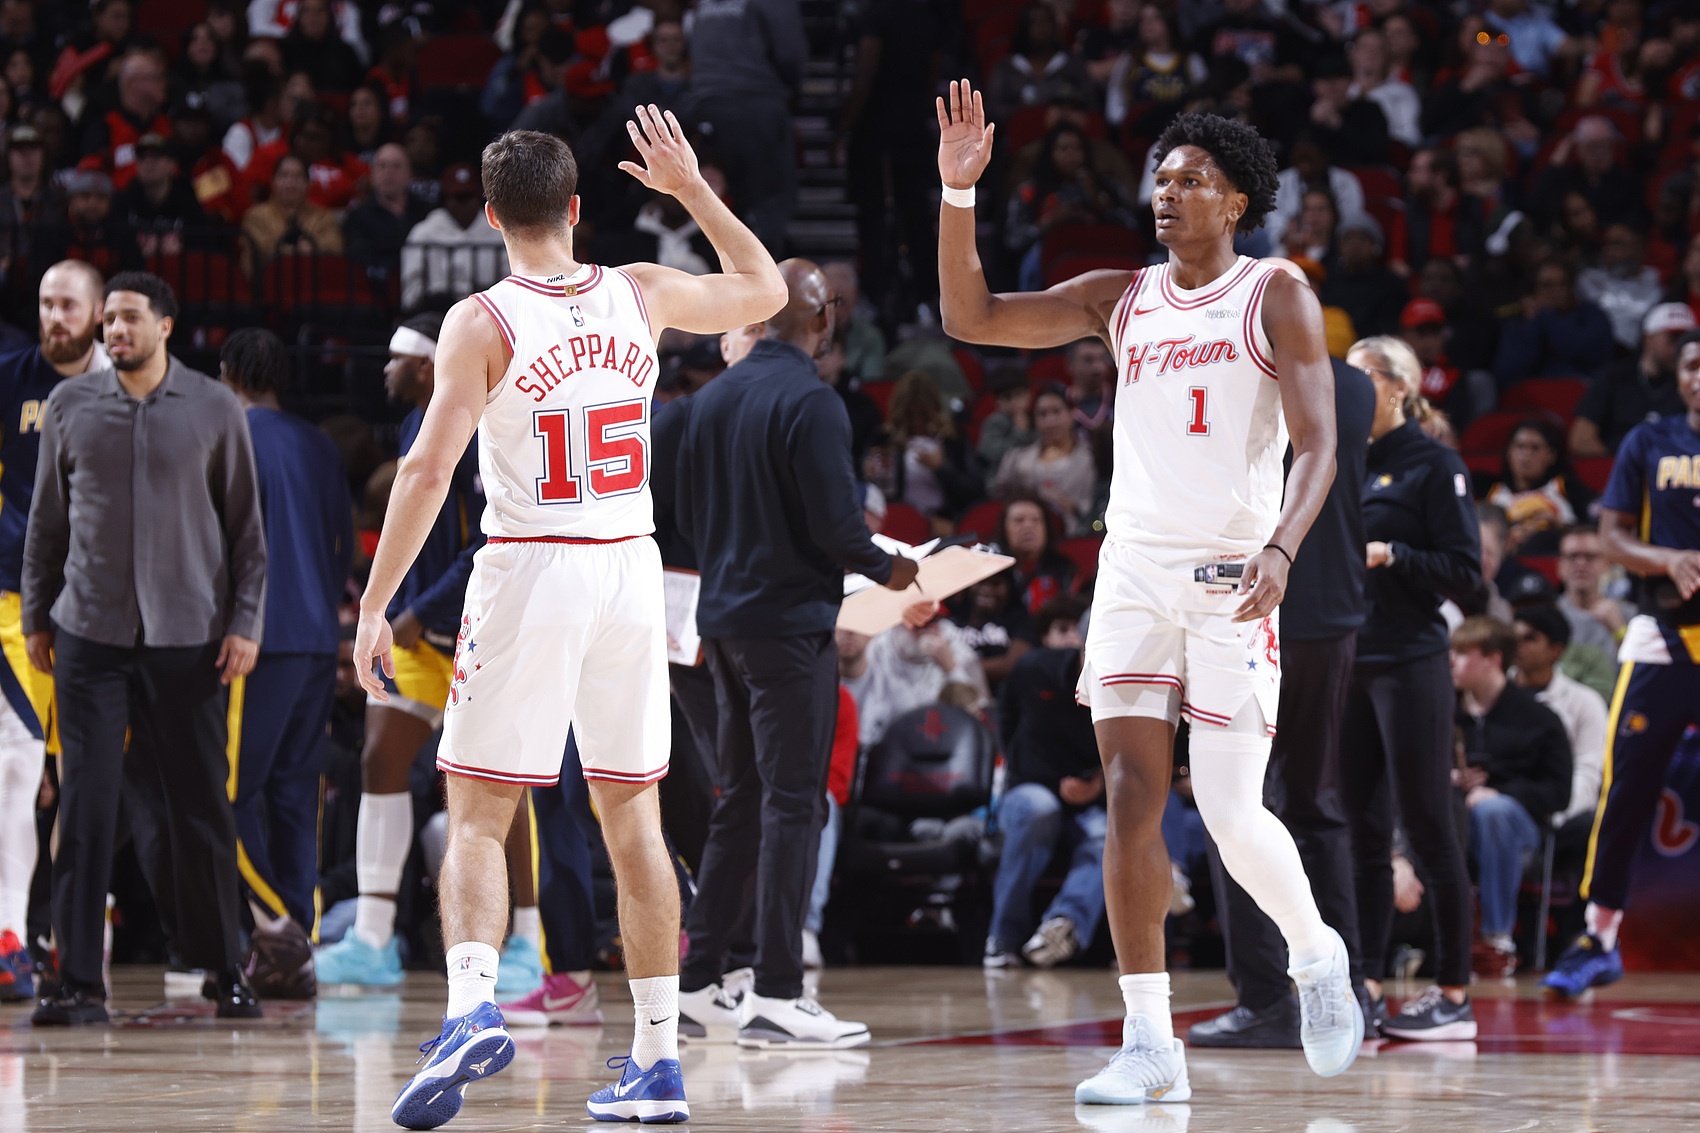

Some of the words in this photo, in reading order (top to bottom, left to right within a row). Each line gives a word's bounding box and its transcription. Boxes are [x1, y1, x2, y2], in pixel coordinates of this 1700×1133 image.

[547, 275, 565, 283] NIKE
[515, 334, 653, 402] SHEPPARD
[1124, 334, 1239, 387] H-Town
[1186, 386, 1210, 436] 1
[533, 397, 648, 505] 15
